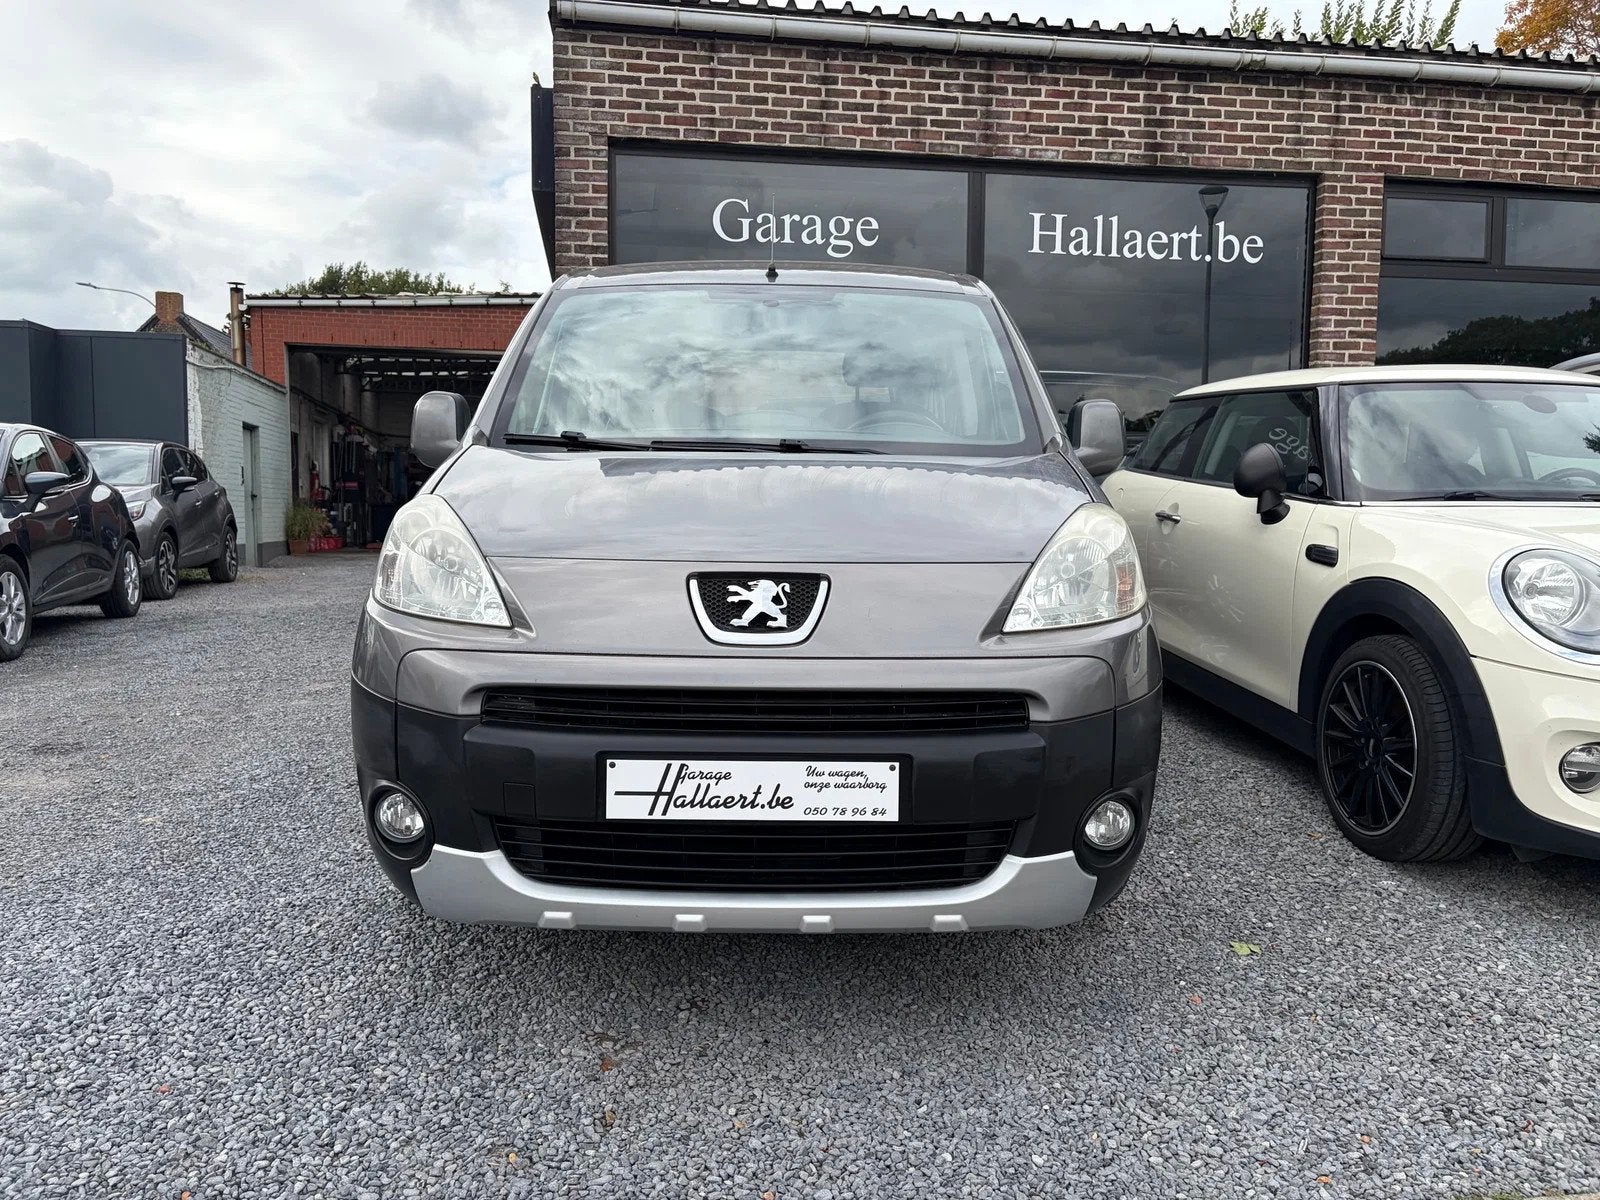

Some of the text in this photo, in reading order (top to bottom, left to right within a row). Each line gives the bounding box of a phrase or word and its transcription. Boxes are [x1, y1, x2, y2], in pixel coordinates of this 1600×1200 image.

[712, 197, 1264, 264] Garage Hallaert.be
[679, 764, 732, 786] Garage
[805, 765, 868, 781] Uw wagen,
[614, 763, 795, 817] Hallaert.be
[804, 777, 888, 793] onze waarborg
[803, 807, 888, 817] 050 78 96 84
